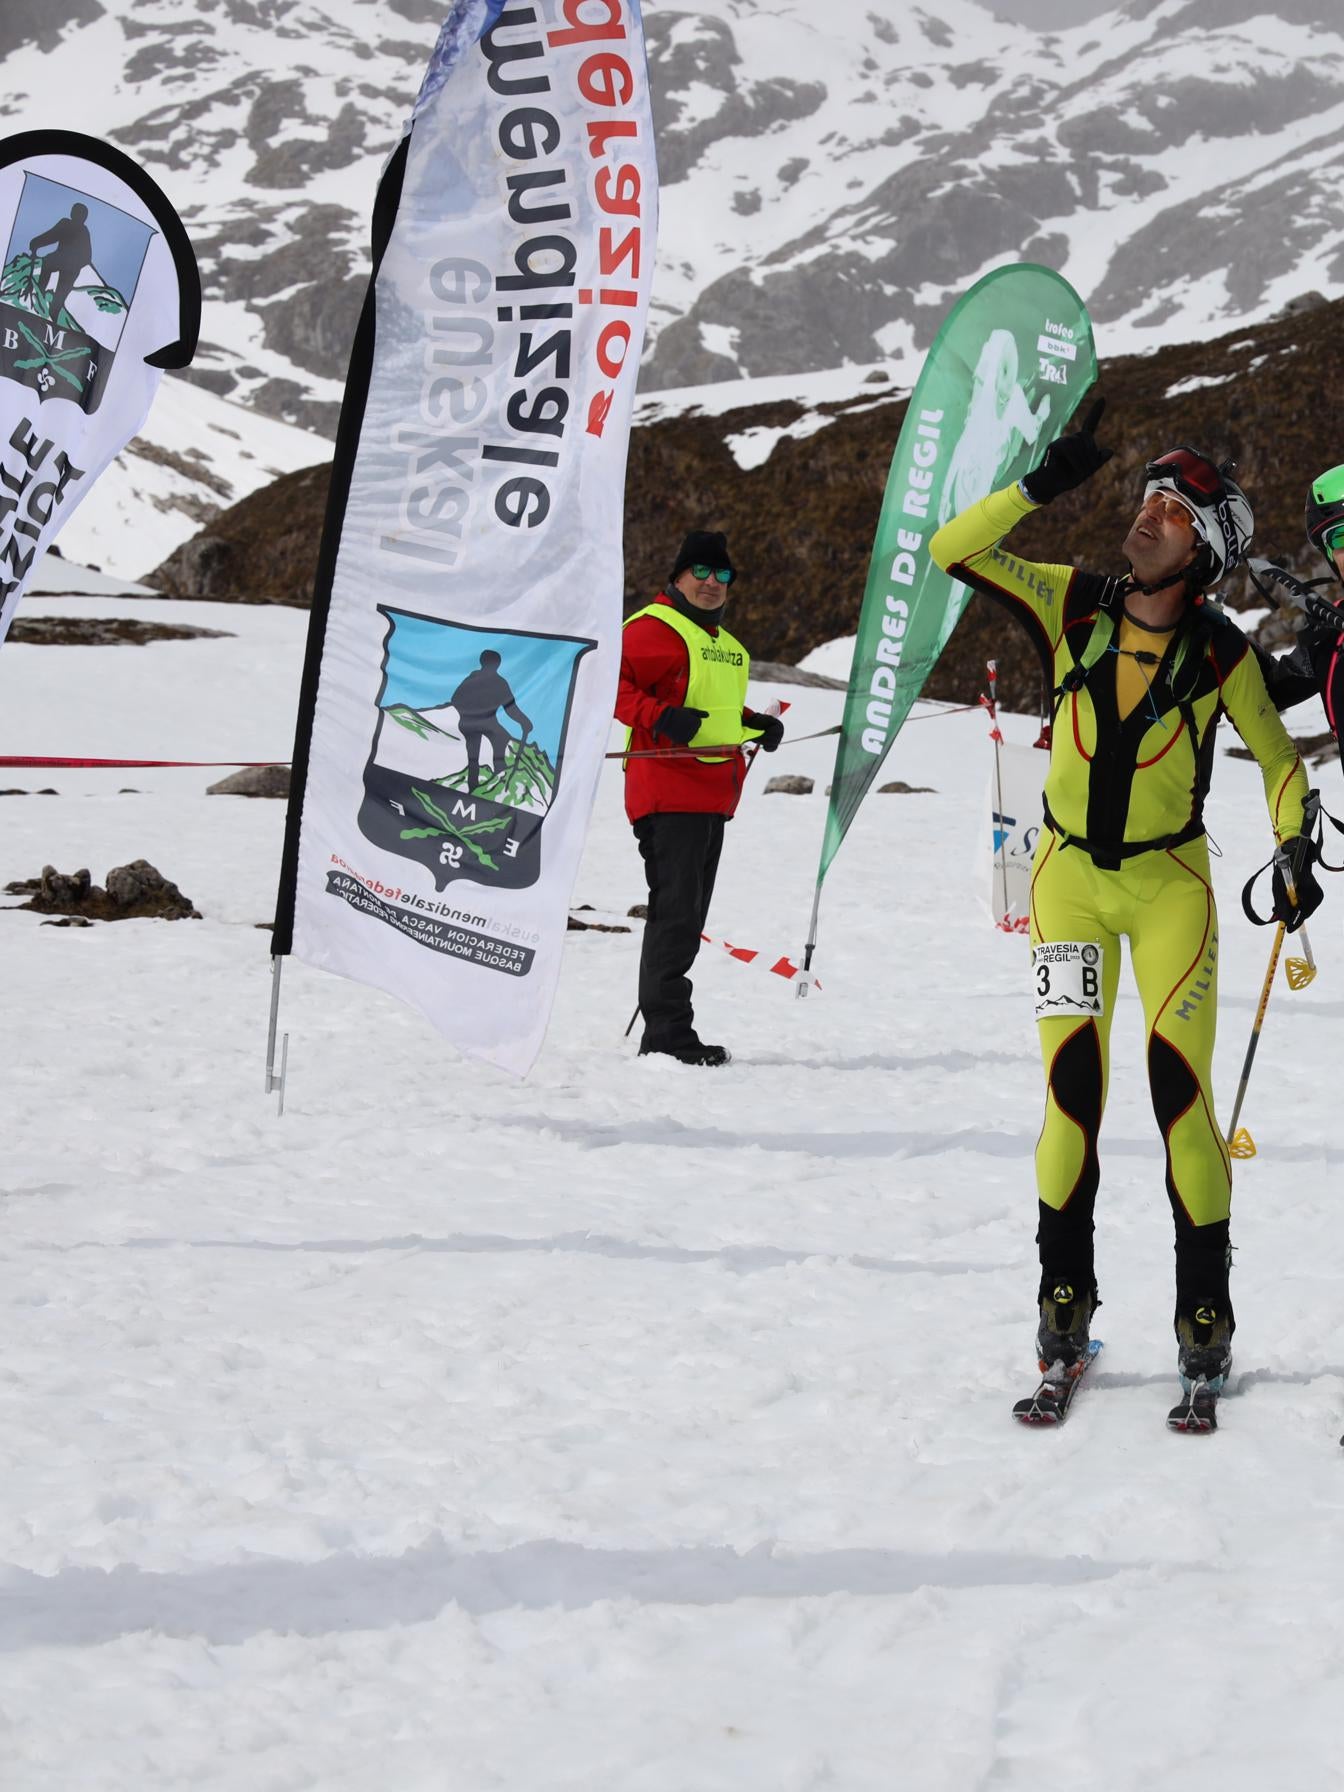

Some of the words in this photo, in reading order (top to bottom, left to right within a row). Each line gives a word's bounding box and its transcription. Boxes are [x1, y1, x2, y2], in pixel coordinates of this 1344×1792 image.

[3, 329, 19, 350] B
[45, 324, 64, 350] M
[1045, 318, 1073, 339] trofeo
[903, 408, 944, 519] REGIL
[890, 528, 923, 586] DE
[992, 550, 1055, 607] MILLET
[862, 595, 907, 755] ANDRES
[1037, 965, 1050, 996] 3
[1082, 966, 1099, 997] B
[1044, 953, 1071, 963] REGIL
[1175, 932, 1219, 1021] MILLET
